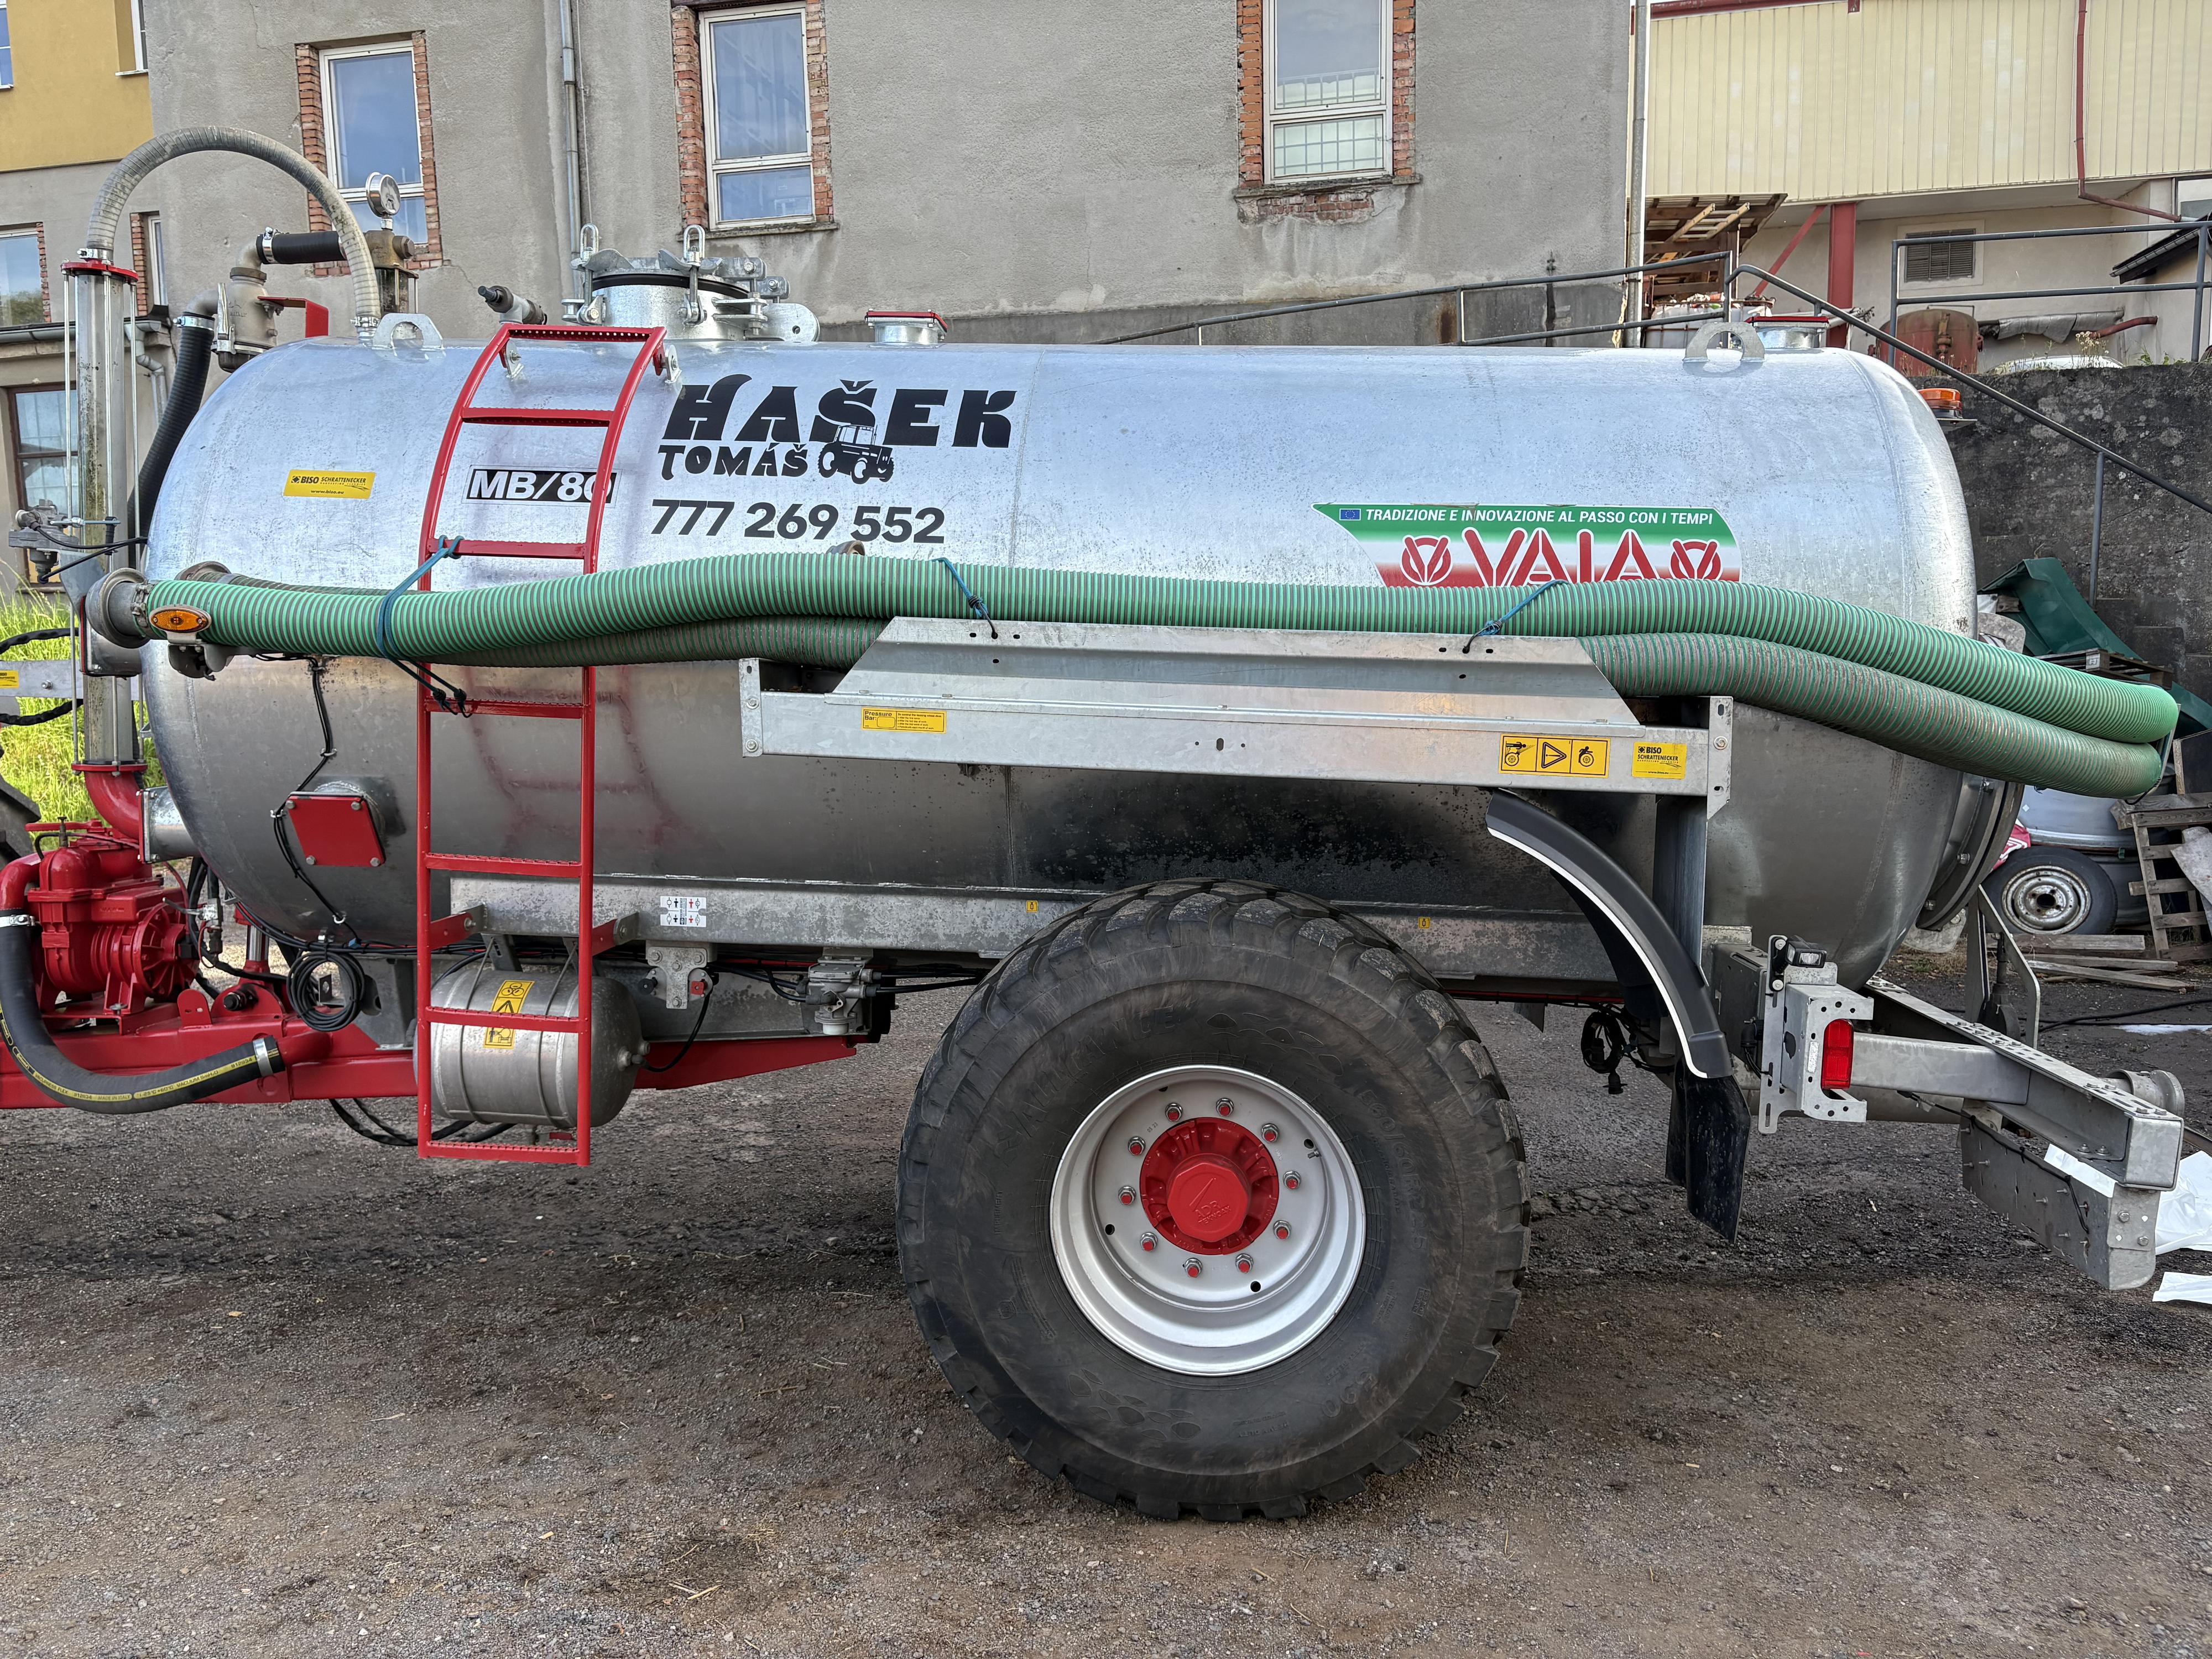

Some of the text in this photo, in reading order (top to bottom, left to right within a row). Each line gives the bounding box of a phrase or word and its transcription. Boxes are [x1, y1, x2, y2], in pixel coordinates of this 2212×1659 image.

[662, 374, 1016, 448] HAŠEK
[659, 443, 808, 481] TOMÁŠ
[651, 499, 945, 544] 777 269 552
[1366, 509, 1713, 525] TRADIZIONE E INNOVAZIONE AL PASSO CON I TEMPI
[1463, 528, 1659, 587] VAIA
[176, 1077, 200, 1087] VACUUM
[1194, 1201, 1220, 1217] ADR
